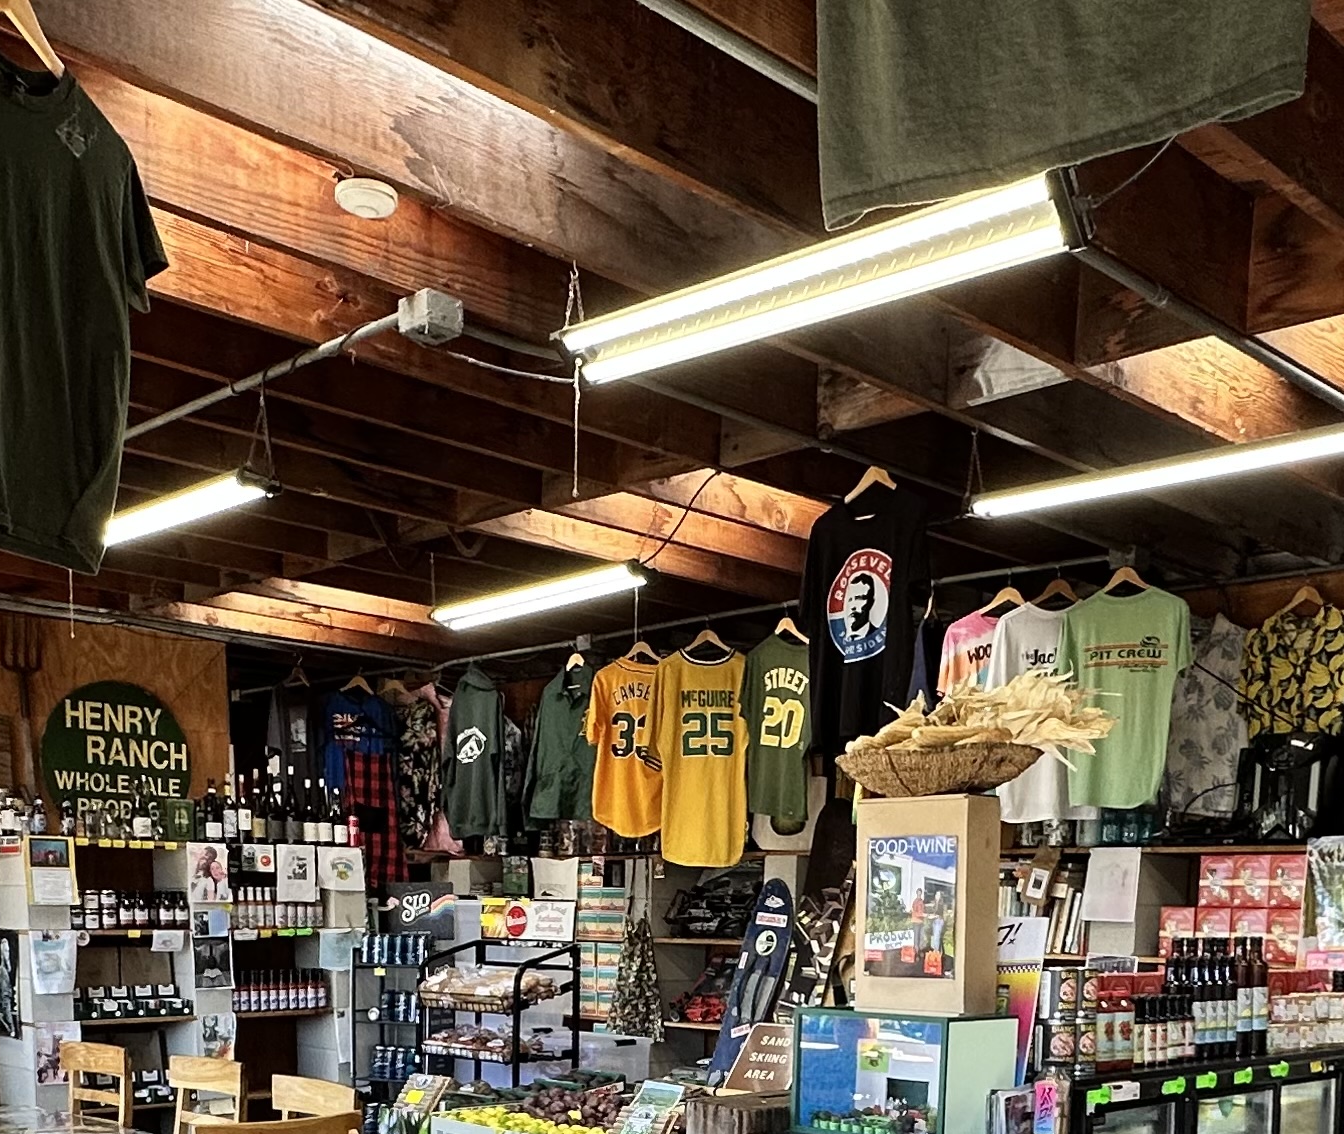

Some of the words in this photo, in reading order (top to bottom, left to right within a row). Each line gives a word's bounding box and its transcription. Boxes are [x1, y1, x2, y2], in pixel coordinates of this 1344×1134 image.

[834, 555, 892, 601] ROOSEVEL
[967, 643, 993, 665] WOO
[1090, 650, 1113, 661] PIT
[1117, 648, 1162, 660] CREW
[613, 681, 651, 706] CANSE
[64, 699, 162, 736] HENRY
[759, 695, 805, 750] 20
[682, 711, 736, 757] 25
[87, 736, 189, 772] RANCH
[54, 769, 183, 798] WHOLEALE
[401, 892, 431, 923] SLO
[760, 1035, 792, 1047] SAND
[749, 1052, 788, 1065] SKIING
[744, 1069, 775, 1081] AREA
